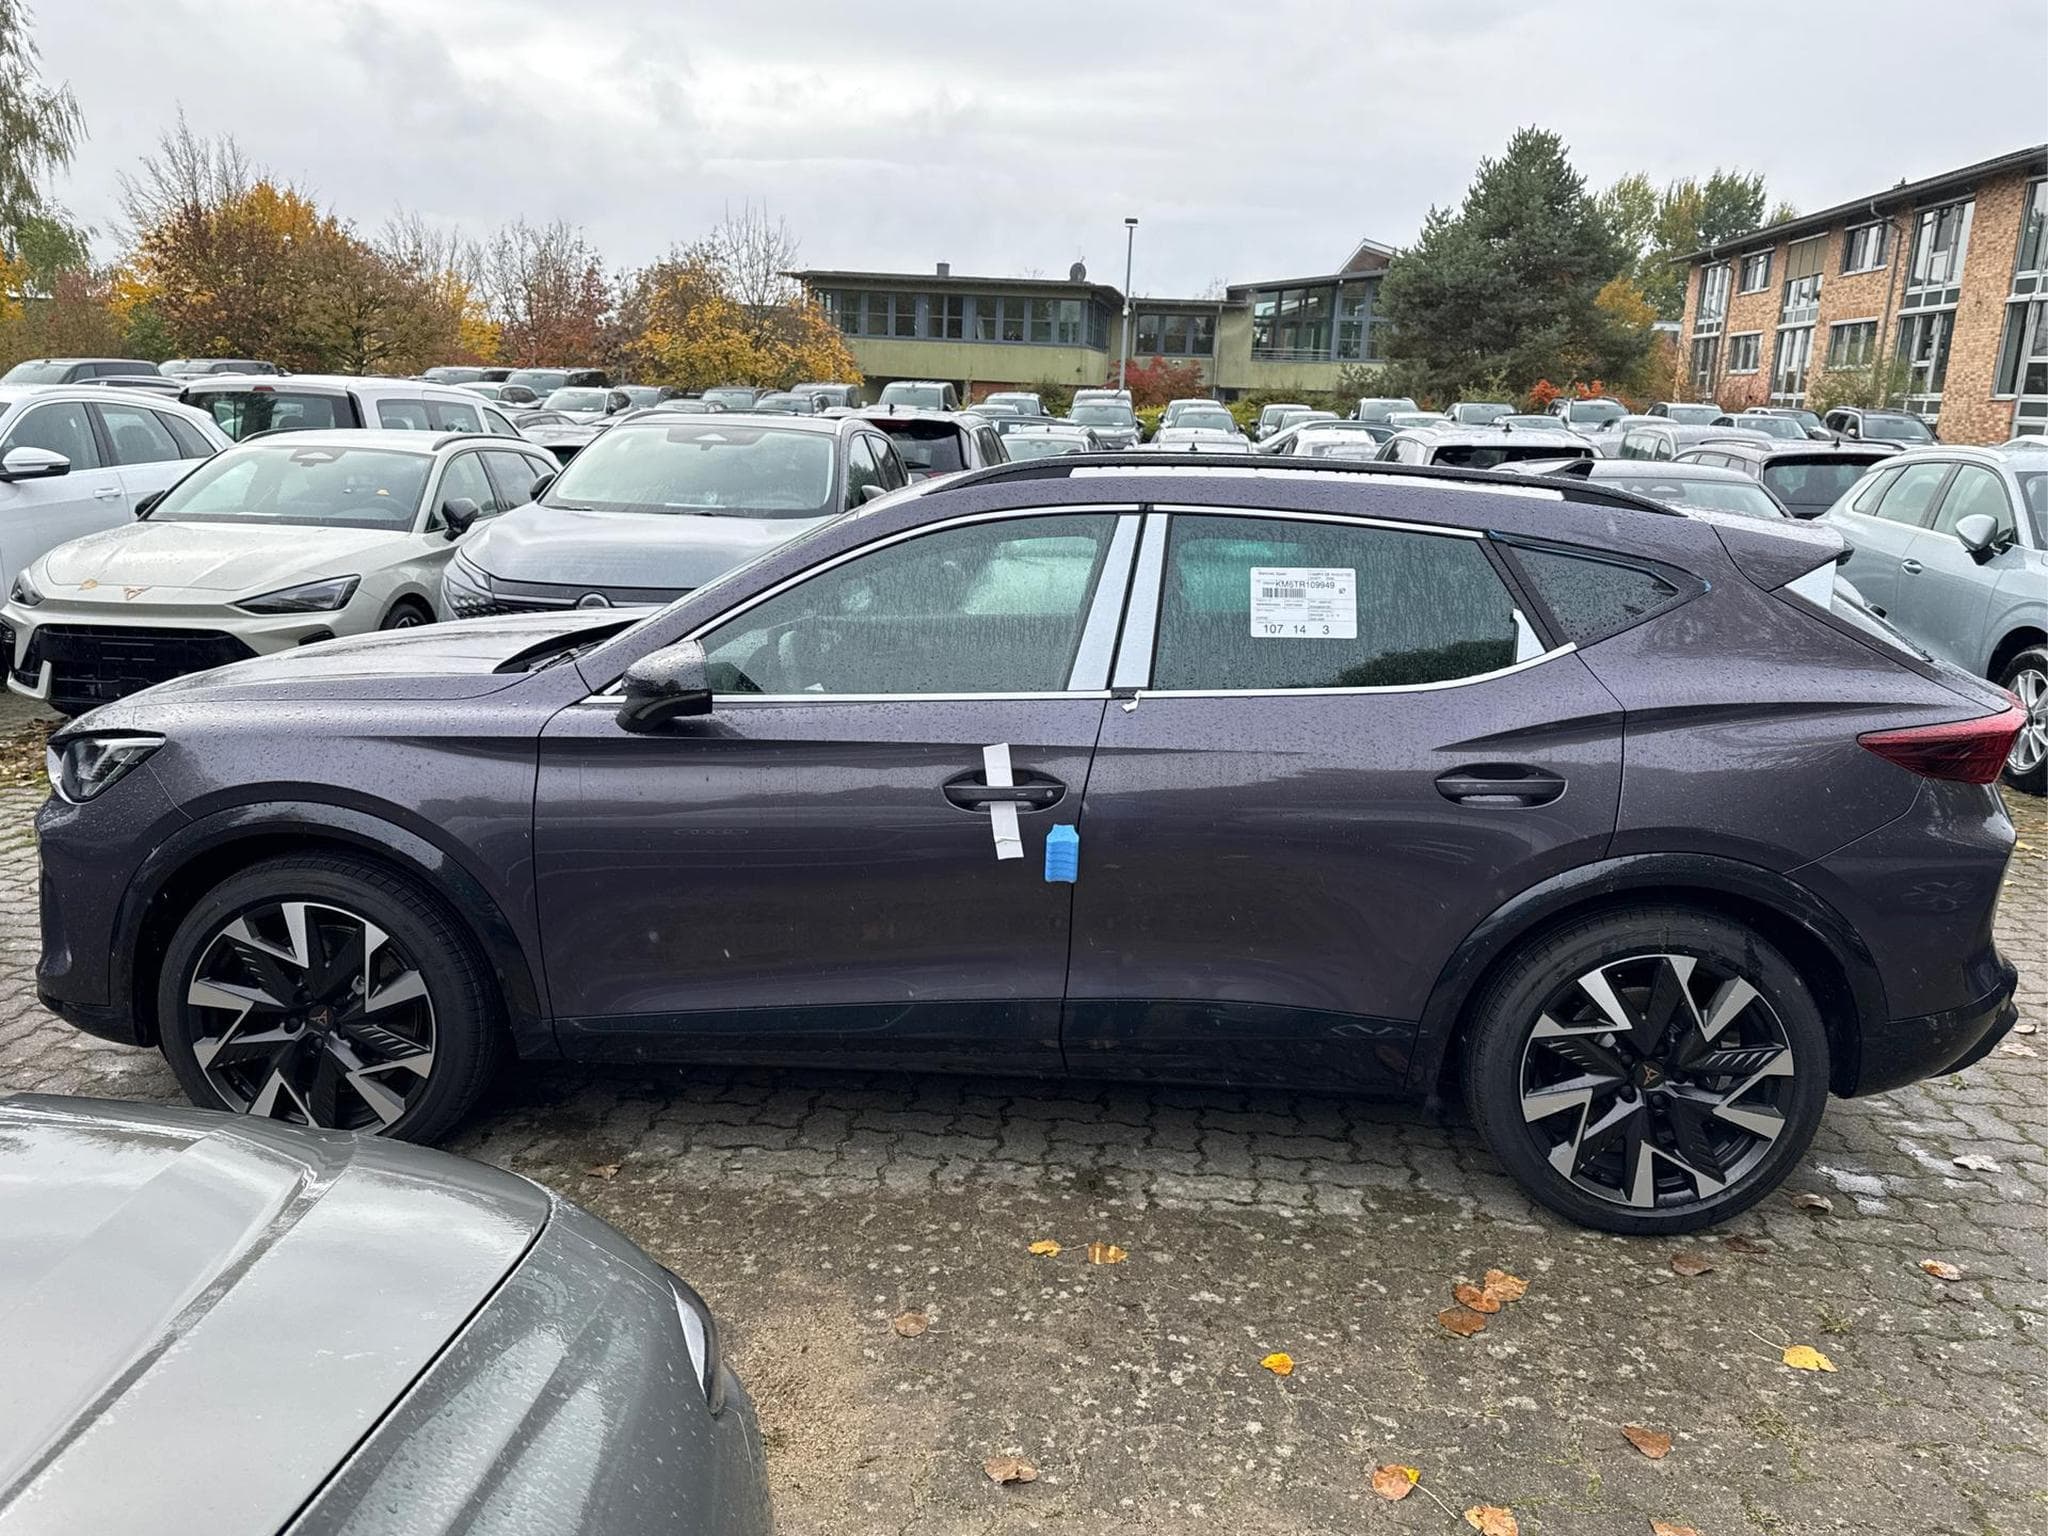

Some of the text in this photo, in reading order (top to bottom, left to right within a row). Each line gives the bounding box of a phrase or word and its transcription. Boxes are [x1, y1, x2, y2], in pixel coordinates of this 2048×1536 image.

[1263, 624, 1330, 635] 107 14 3
